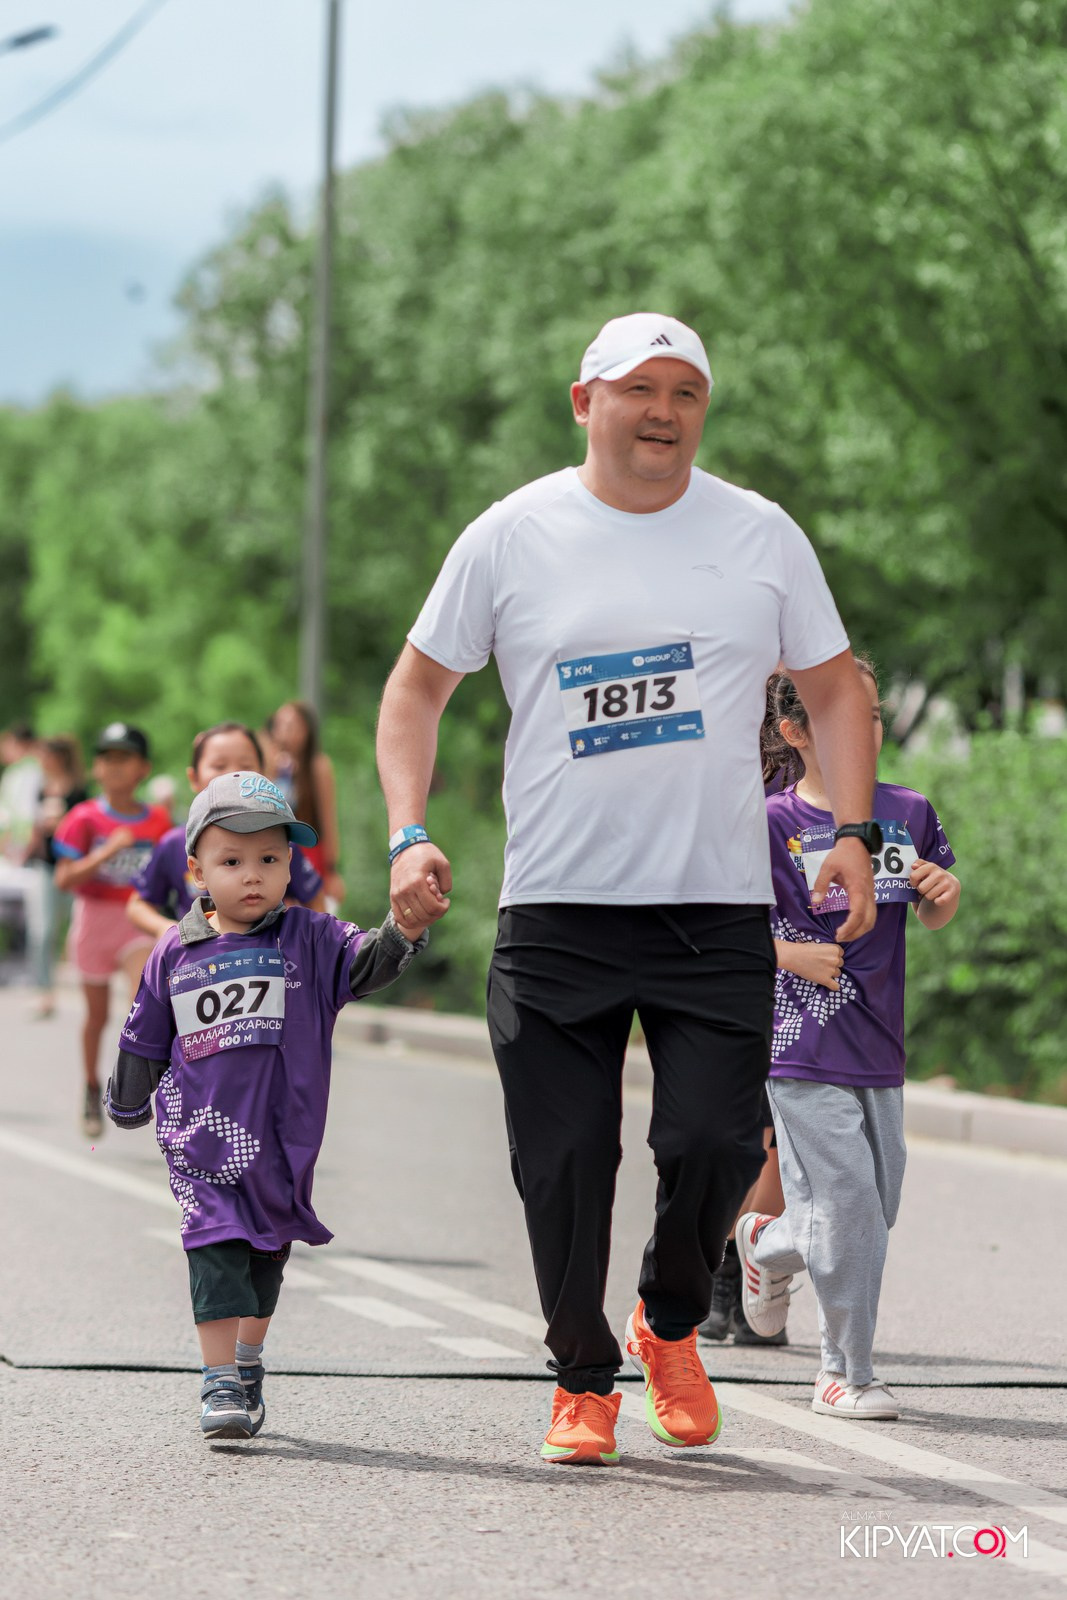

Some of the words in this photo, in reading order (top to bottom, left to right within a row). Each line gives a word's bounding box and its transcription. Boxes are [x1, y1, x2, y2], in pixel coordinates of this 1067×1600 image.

[644, 653, 671, 664] GROUP
[574, 664, 593, 677] KM
[583, 676, 677, 723] 1813
[179, 971, 197, 982] GROUP
[196, 980, 271, 1025] 027
[185, 1024, 232, 1048] БАЛАЛАР
[234, 1019, 283, 1033] ЖАРЫСЫ
[218, 1034, 241, 1048] 600
